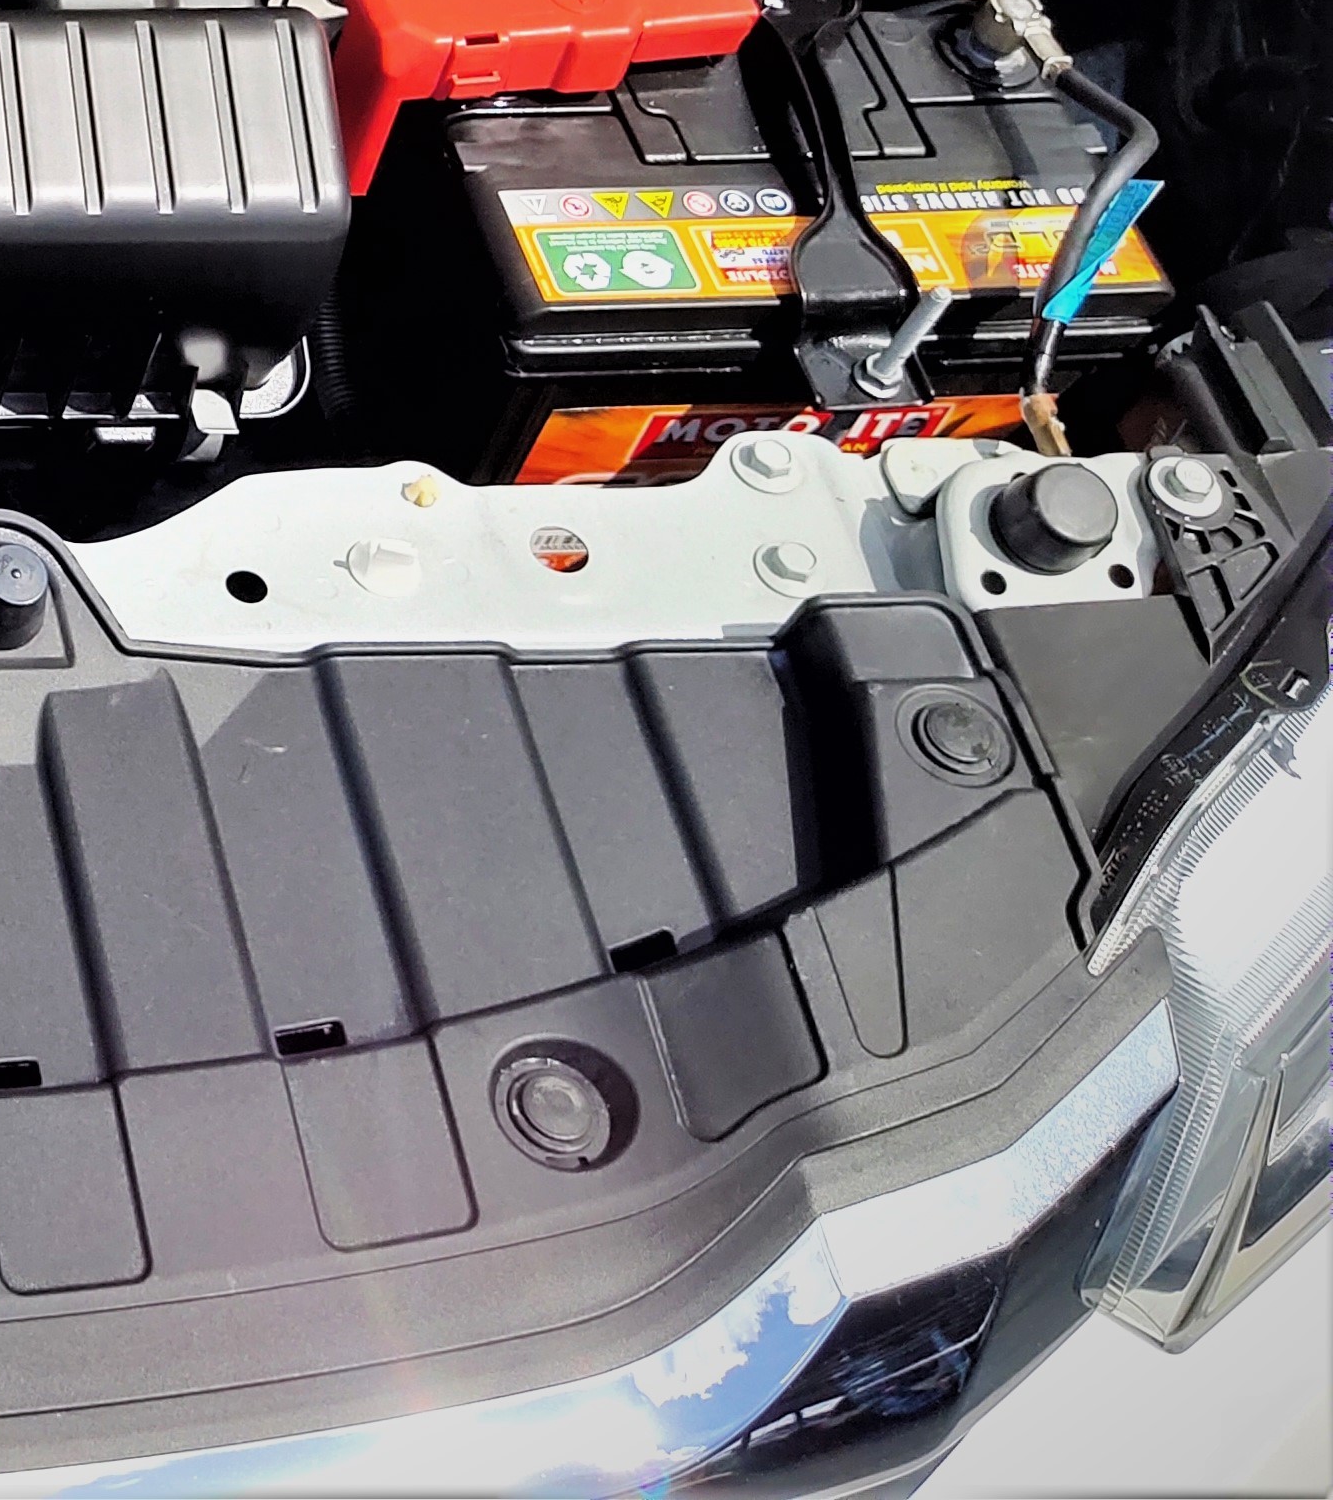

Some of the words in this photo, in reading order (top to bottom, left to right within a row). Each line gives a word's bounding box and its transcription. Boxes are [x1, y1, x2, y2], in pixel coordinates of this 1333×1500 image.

[859, 193, 906, 212] STIC
[913, 190, 999, 210] REMOVE
[1006, 188, 1051, 207] NOT
[654, 410, 931, 443] MOTOITE
